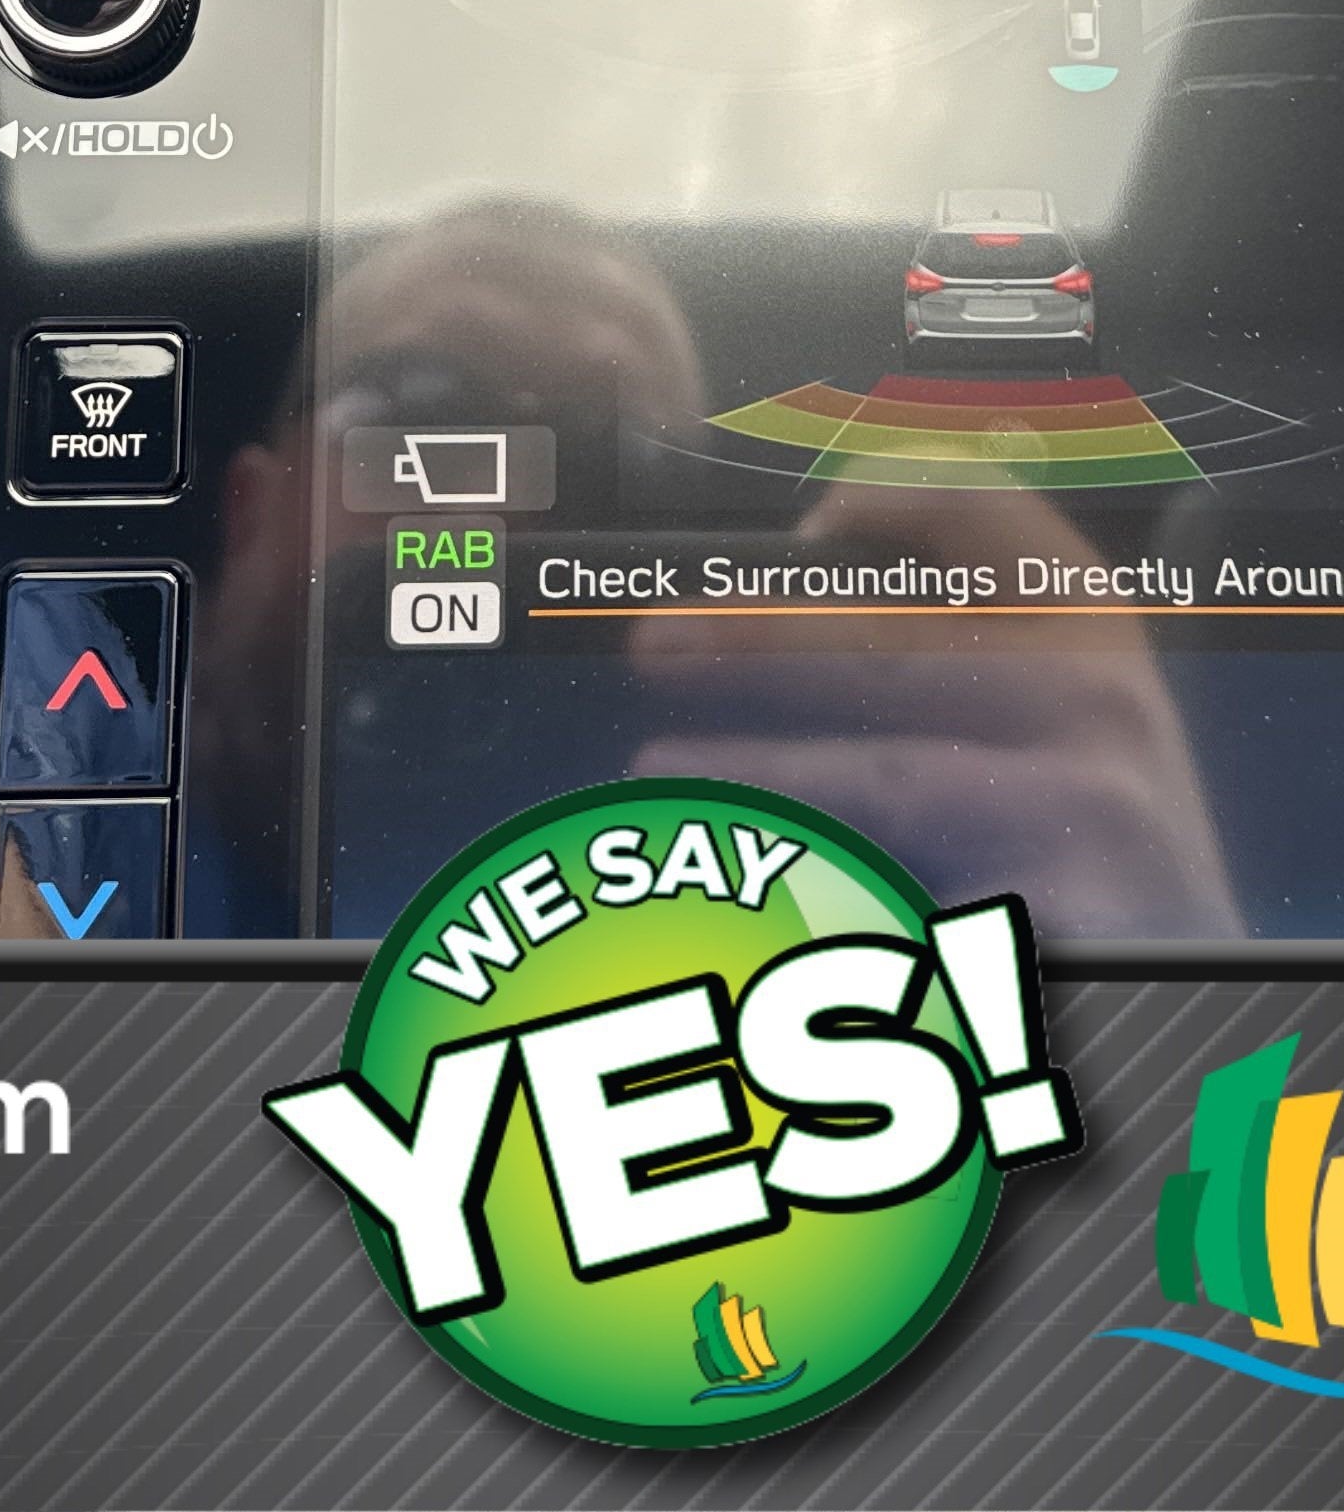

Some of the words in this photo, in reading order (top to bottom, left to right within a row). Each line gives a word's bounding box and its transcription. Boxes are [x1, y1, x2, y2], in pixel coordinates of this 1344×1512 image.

[50, 433, 147, 458] FRONT
[394, 530, 495, 570] RAB
[537, 558, 679, 599] Check
[701, 557, 997, 606] Surroundings
[1017, 557, 1194, 605] Directly
[409, 594, 480, 634] ON
